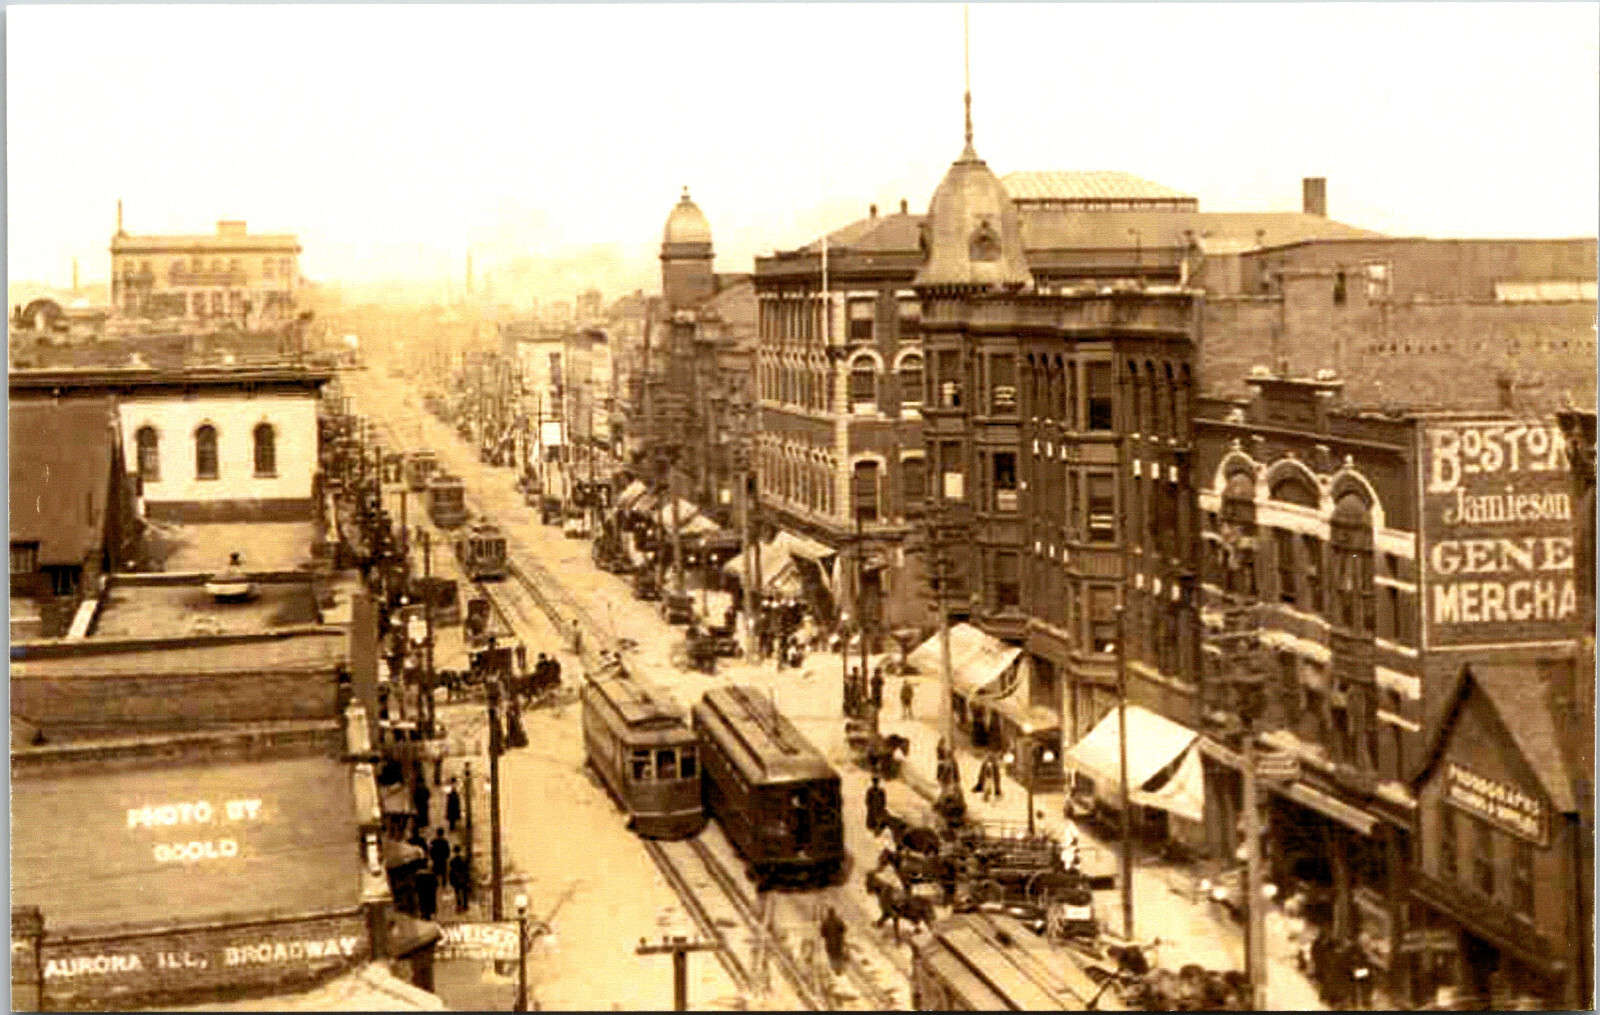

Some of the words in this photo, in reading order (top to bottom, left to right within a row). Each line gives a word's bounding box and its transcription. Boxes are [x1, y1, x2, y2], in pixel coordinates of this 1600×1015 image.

[1443, 486, 1571, 525] Jamieson
[1432, 536, 1574, 575] GENE
[1433, 579, 1577, 624] MERCHA
